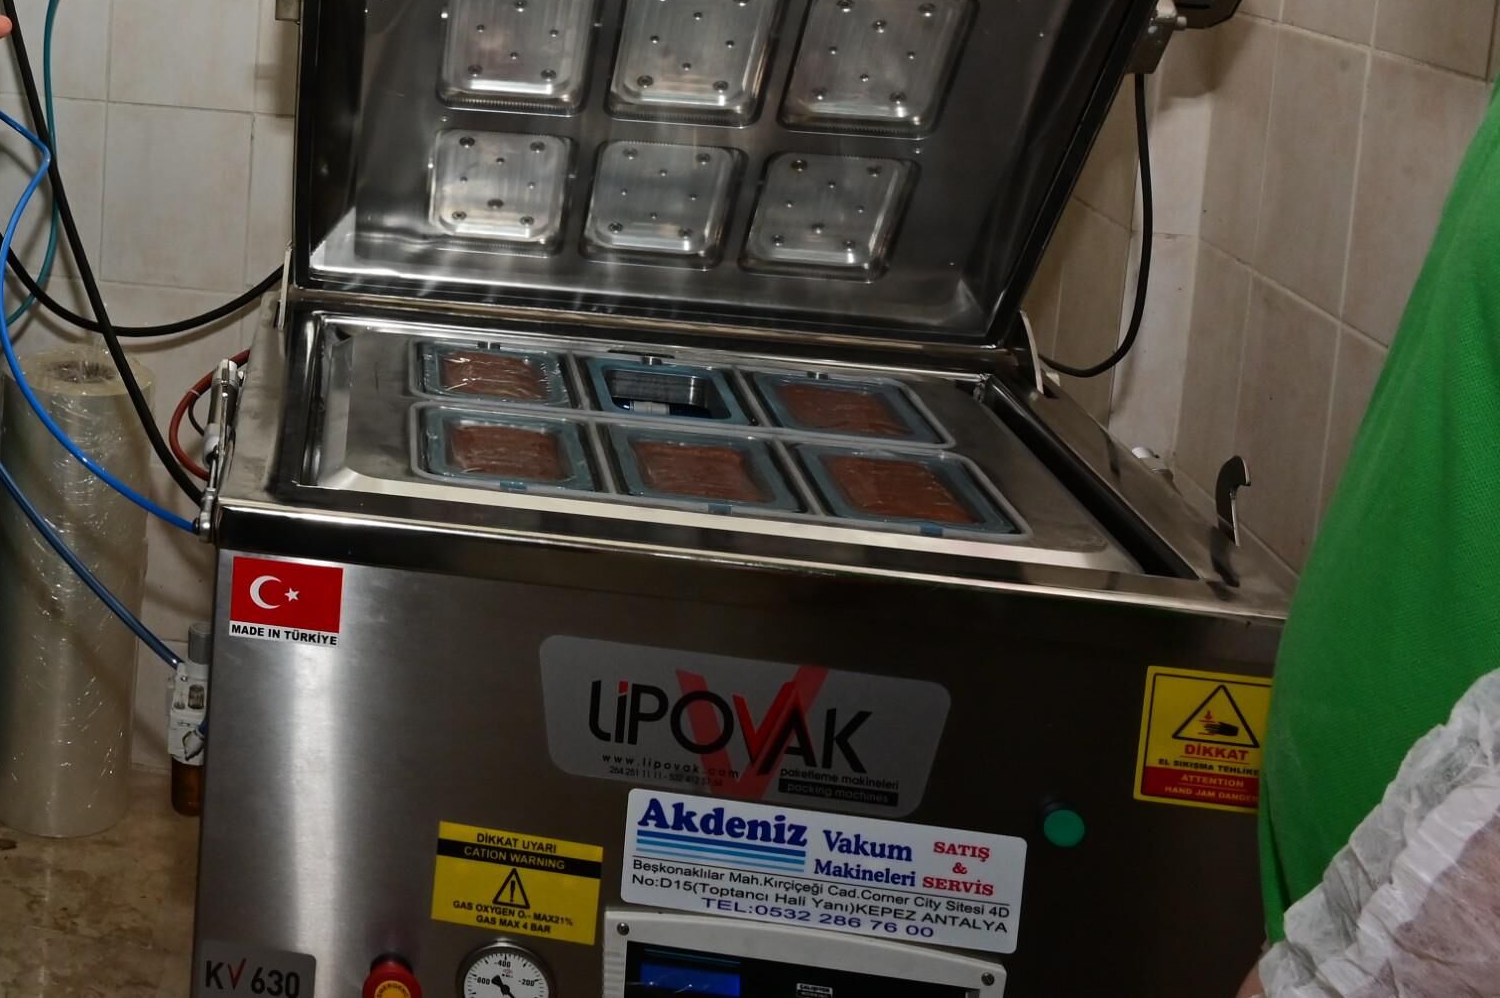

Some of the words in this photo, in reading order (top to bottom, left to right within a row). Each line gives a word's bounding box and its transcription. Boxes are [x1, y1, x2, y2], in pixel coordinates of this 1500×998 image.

[231, 624, 264, 637] MADE
[268, 629, 280, 639] IN
[283, 630, 338, 645] TÜRKİYE
[1158, 758, 1170, 766] EL
[1184, 743, 1249, 761] DİKKAT
[780, 768, 838, 782] paketleme
[841, 775, 899, 790] makineleri
[787, 783, 833, 797] packing
[1180, 774, 1244, 788] ATTENTION
[1164, 785, 1193, 795] HAND
[1195, 788, 1216, 797] JAM
[637, 797, 808, 847] Akdeniz
[476, 832, 518, 848] DİKKAT
[522, 840, 557, 854] UYARI
[822, 829, 913, 862] Vakum
[933, 841, 990, 863] SATIŞ
[464, 846, 507, 861] CATION
[510, 854, 565, 870] WARNING
[952, 862, 968, 875] &
[813, 858, 916, 887] Makineleri
[632, 859, 725, 881] Beşkonaklılar
[827, 884, 909, 906] Cad.Corner
[914, 896, 942, 911] City
[945, 900, 985, 915] Sitesi
[988, 906, 1010, 918] 4D
[922, 875, 995, 896] SERVİS
[453, 900, 473, 911] GAS
[475, 904, 515, 917] OXYGEN
[701, 897, 811, 922] TEL:0532
[819, 913, 861, 929] 286
[870, 920, 898, 933] 76
[906, 925, 934, 938] 00
[775, 893, 806, 907] Hali
[921, 913, 1008, 933] ANTALYA
[476, 915, 497, 925] GAS
[499, 918, 520, 929] MAX
[530, 923, 551, 934] BAR
[250, 967, 300, 998] 630
